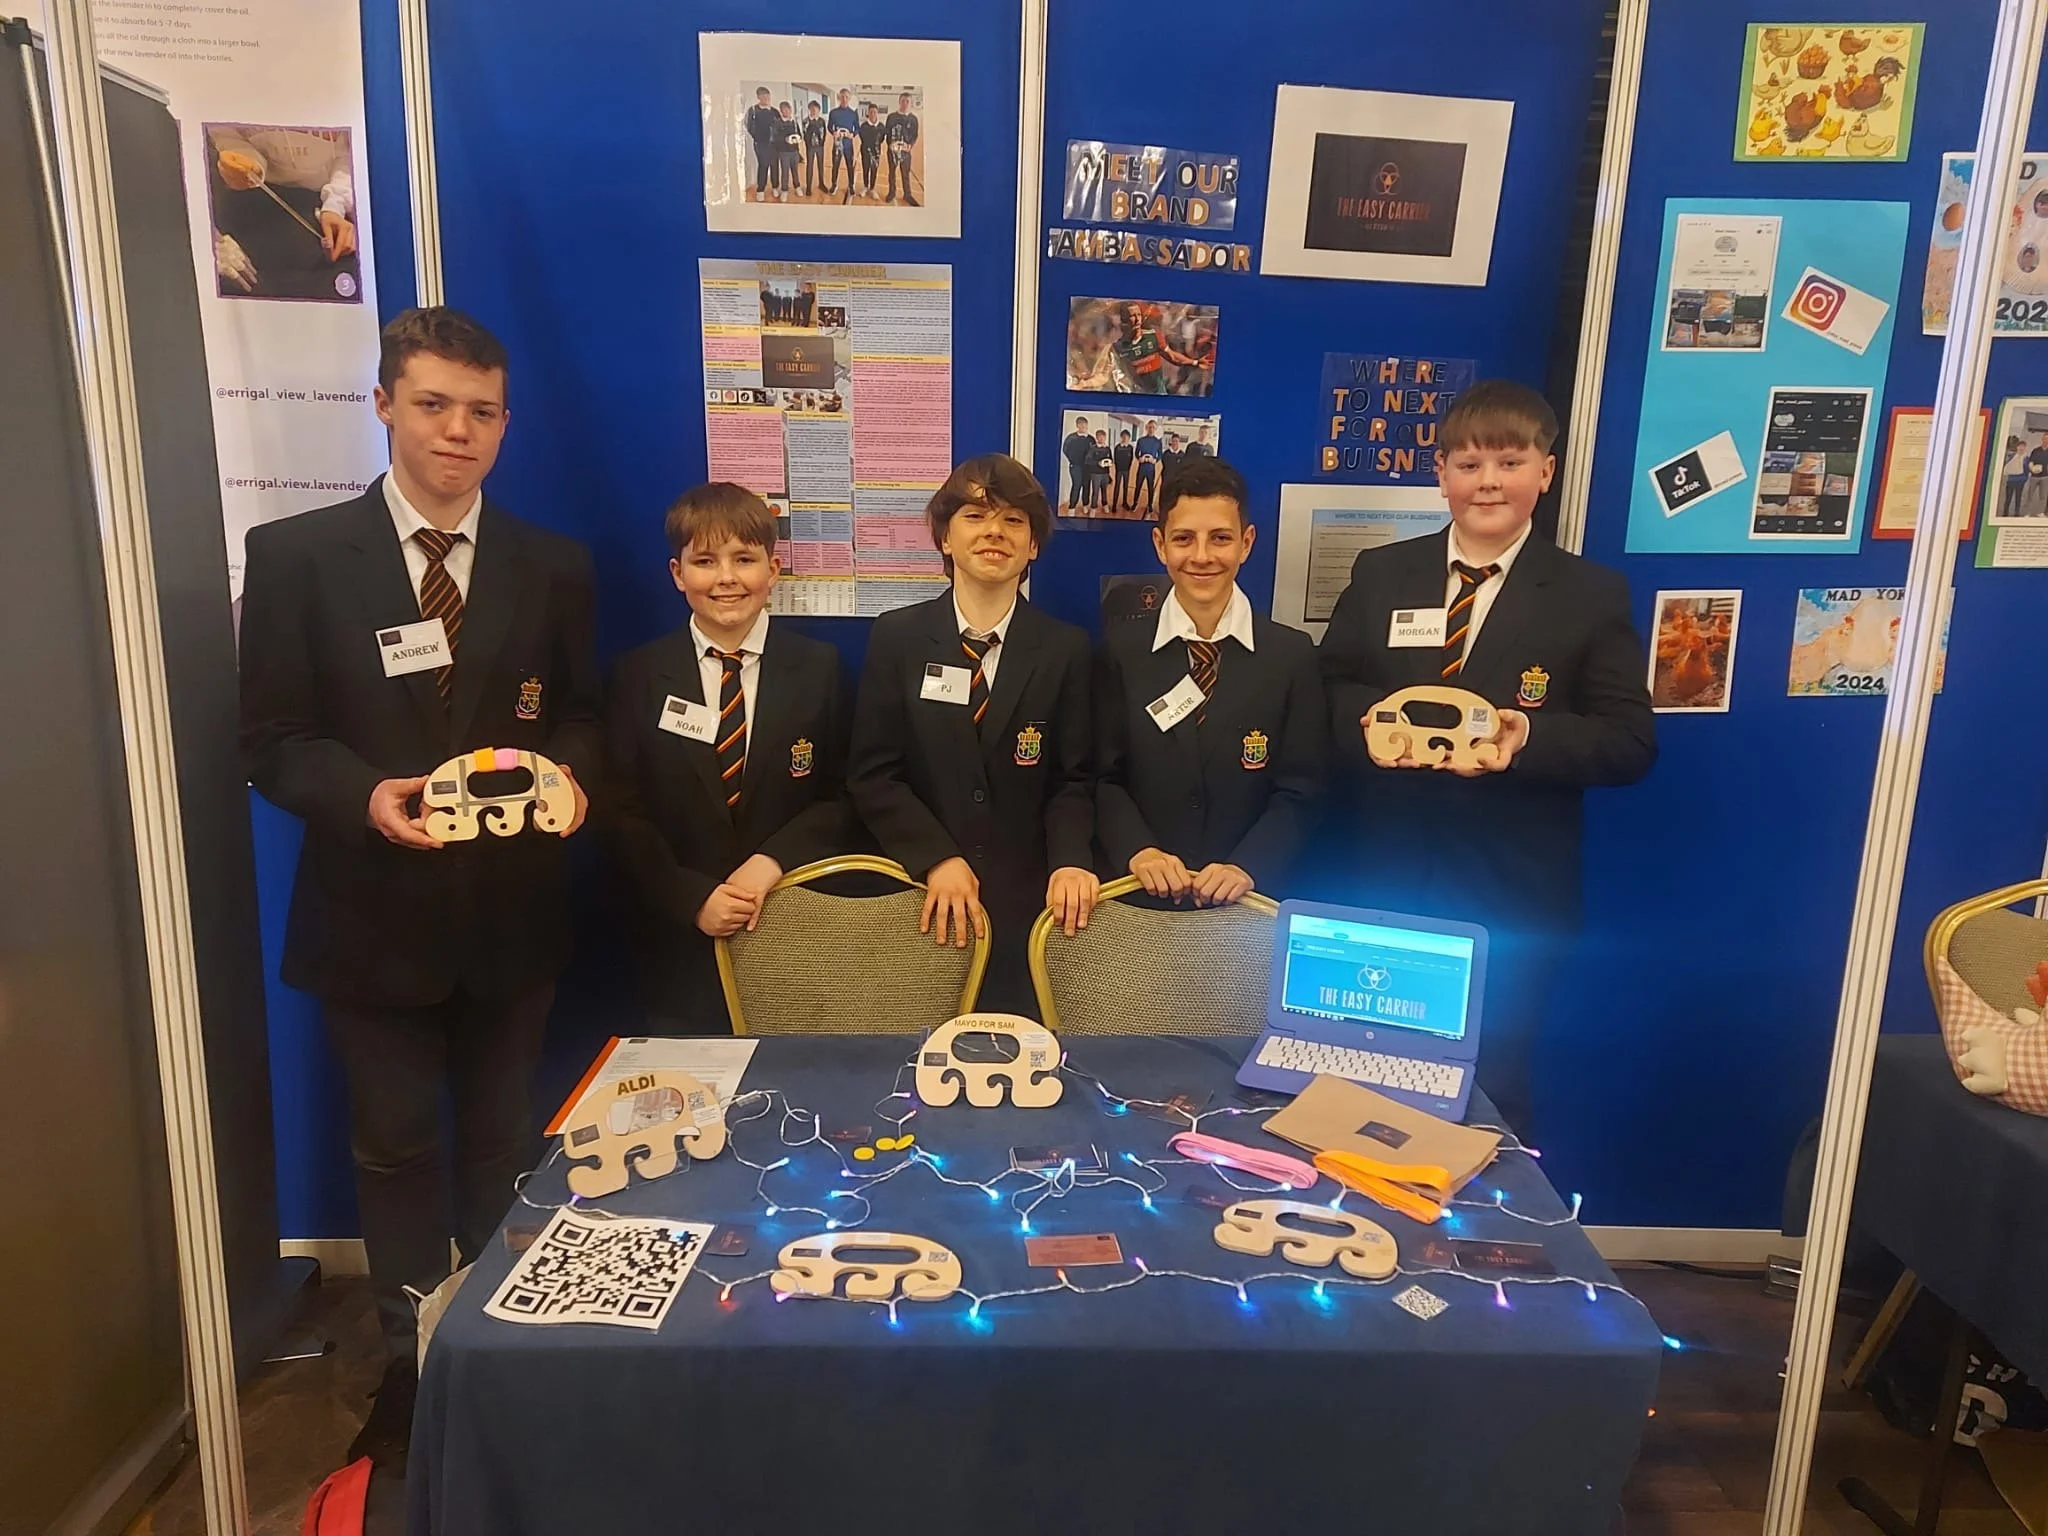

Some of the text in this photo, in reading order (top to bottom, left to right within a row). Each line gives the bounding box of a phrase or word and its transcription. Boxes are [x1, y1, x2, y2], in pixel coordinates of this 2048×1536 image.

[1078, 151, 1239, 195] MEET OUR
[1110, 189, 1210, 226] BRAND
[1357, 198, 1385, 219] EASY
[1055, 228, 1251, 271] AMBASSADOR
[1996, 297, 2048, 323] 202
[1350, 358, 1448, 385] WHERE
[216, 386, 368, 403] @errigal_view_lavender
[1333, 387, 1457, 415] TO NEXT
[1331, 416, 1437, 448] FOR OU
[1322, 446, 1444, 473] BUISNES
[224, 476, 368, 492] @errigal.view.lavender
[1671, 480, 1701, 499] TikTok
[1825, 589, 1862, 602] MAD
[1398, 627, 1440, 637] MORGAN
[391, 641, 440, 661] ANDREW
[941, 684, 952, 693] PJ
[1836, 674, 1885, 690] 2024
[675, 719, 704, 735] NOAH
[1319, 986, 1427, 1021] THE EASY CARRIER
[954, 1019, 1015, 1030] MAYO FOR SAM
[616, 1074, 656, 1096] ALDI
